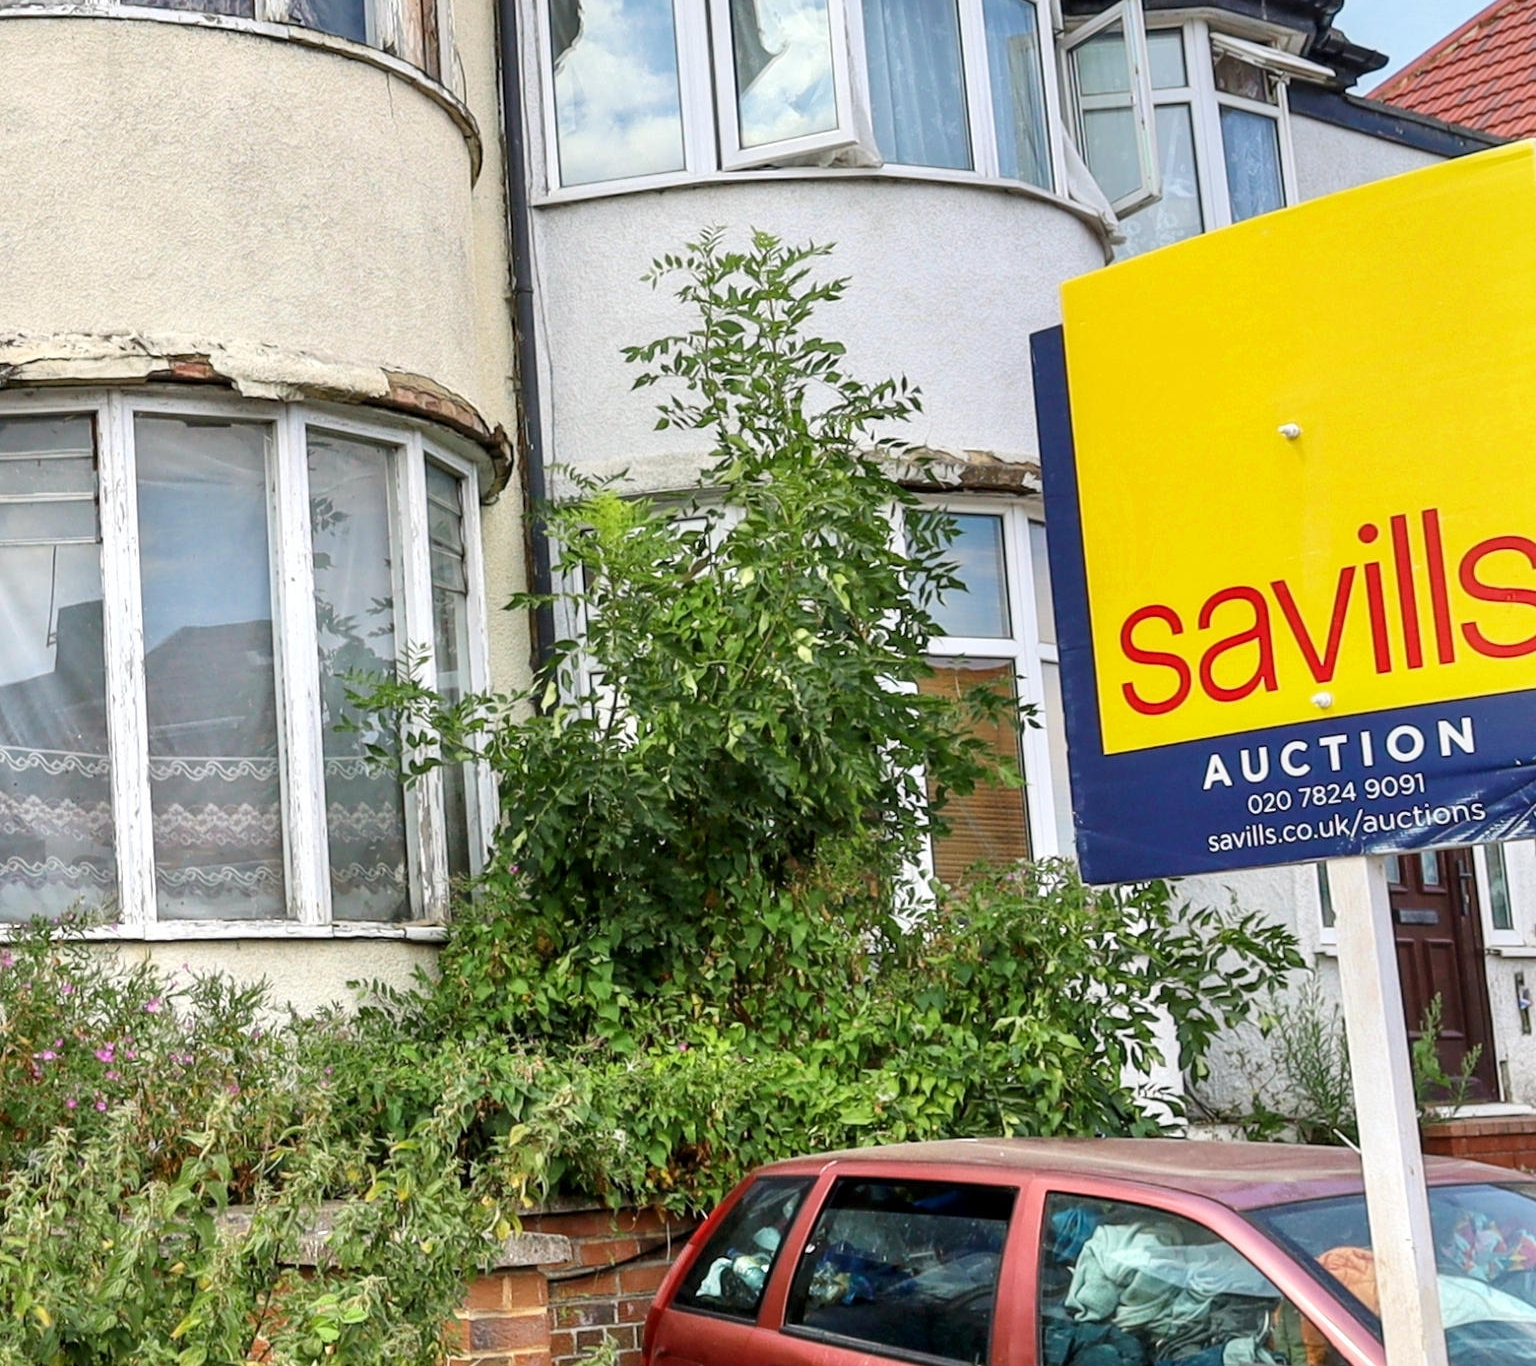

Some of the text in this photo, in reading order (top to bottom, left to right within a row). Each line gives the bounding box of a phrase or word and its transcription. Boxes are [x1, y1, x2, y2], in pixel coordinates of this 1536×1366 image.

[1202, 716, 1476, 791] AUCTION
[1247, 771, 1426, 815] 020 7824 9091
[1207, 801, 1487, 853] savills.co.uk/auctions
